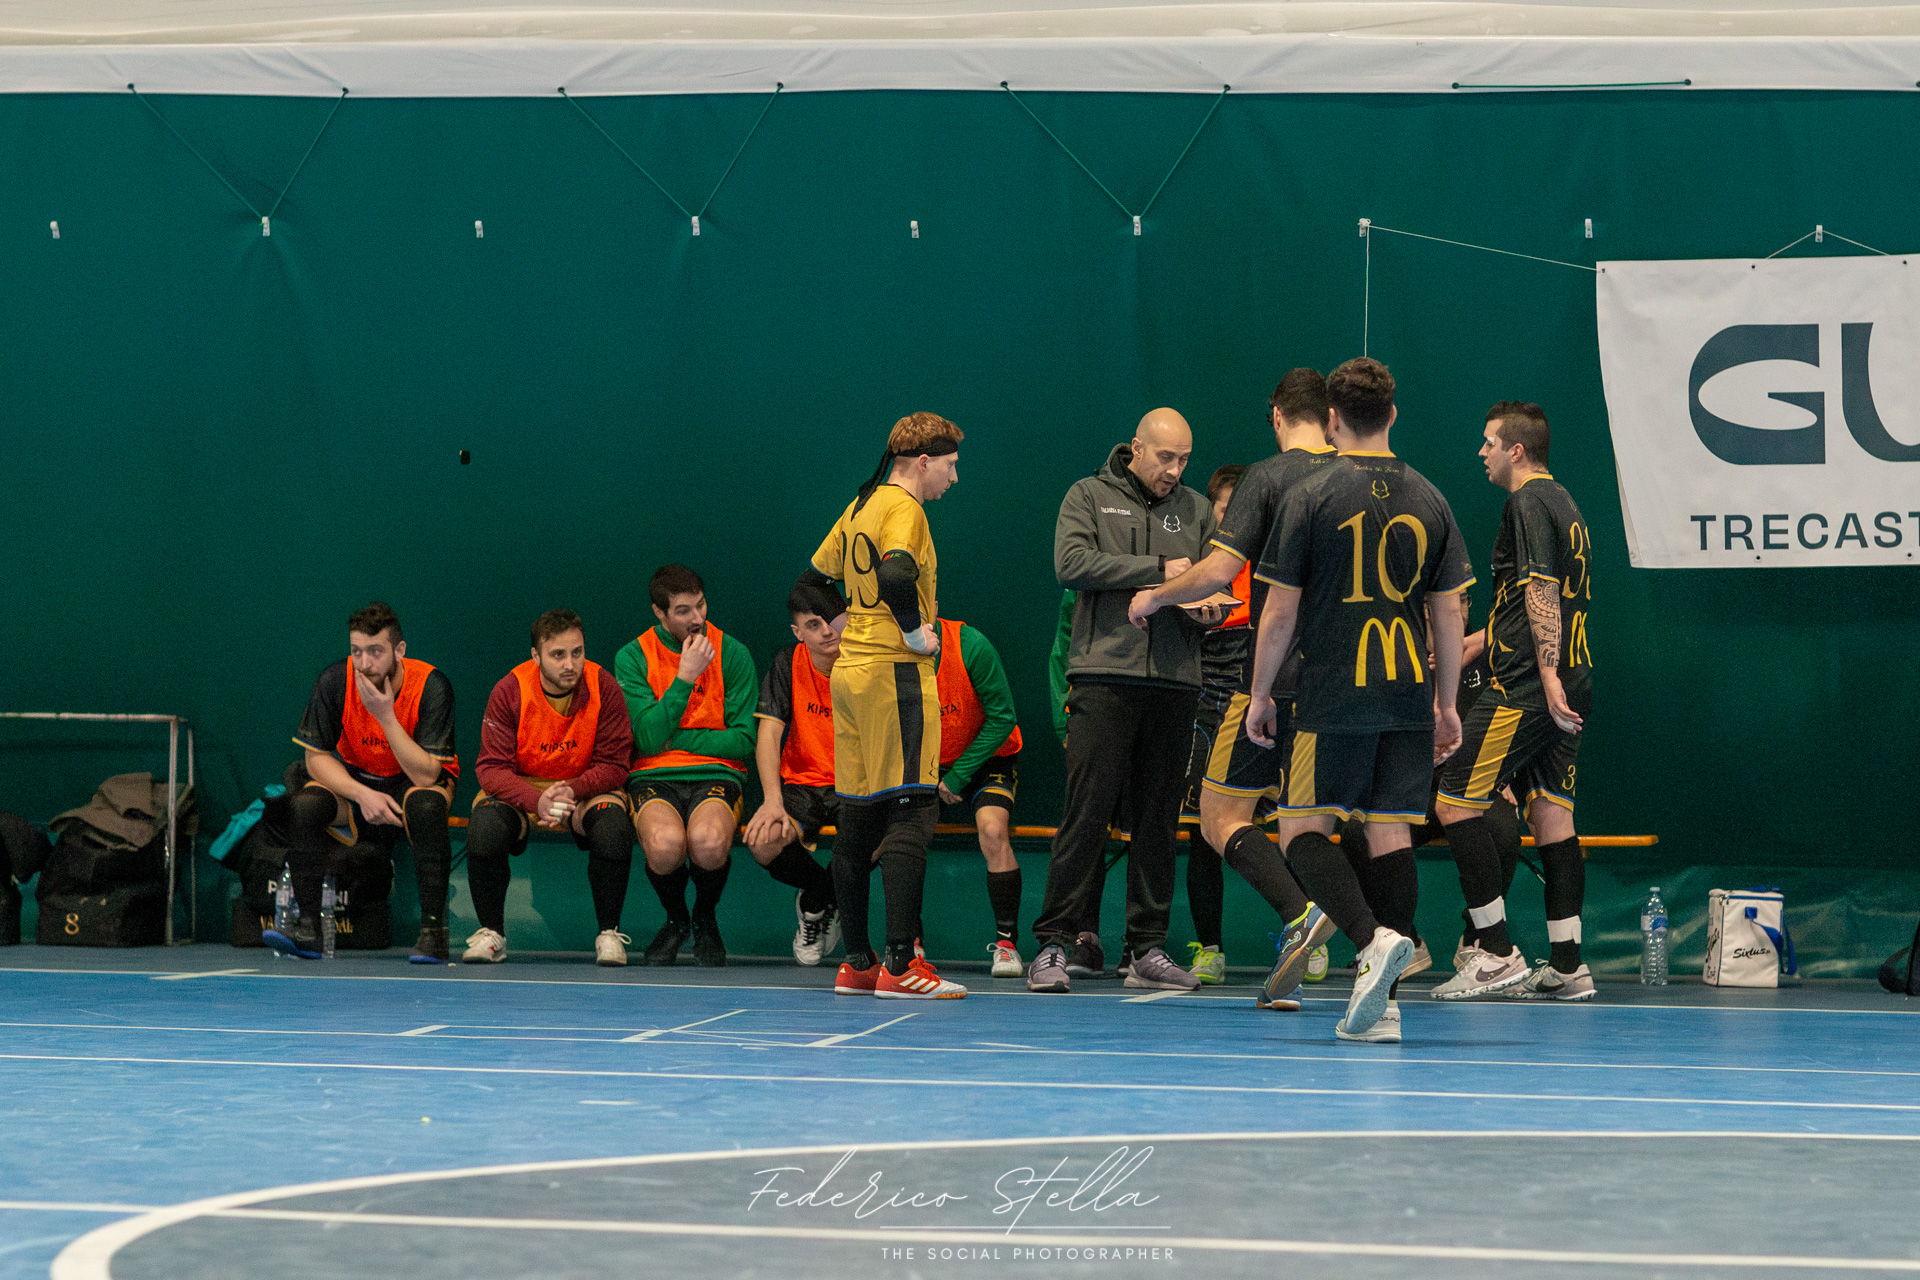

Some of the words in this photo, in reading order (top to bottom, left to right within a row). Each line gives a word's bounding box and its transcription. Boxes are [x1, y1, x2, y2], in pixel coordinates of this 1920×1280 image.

[1338, 511, 1427, 602] 10
[1562, 521, 1592, 601] 3
[807, 702, 832, 717] KIPS
[361, 736, 390, 749] KIPS
[540, 739, 578, 753] KIPSTA
[64, 912, 80, 935] 8
[1733, 947, 1766, 959] Sixtus
